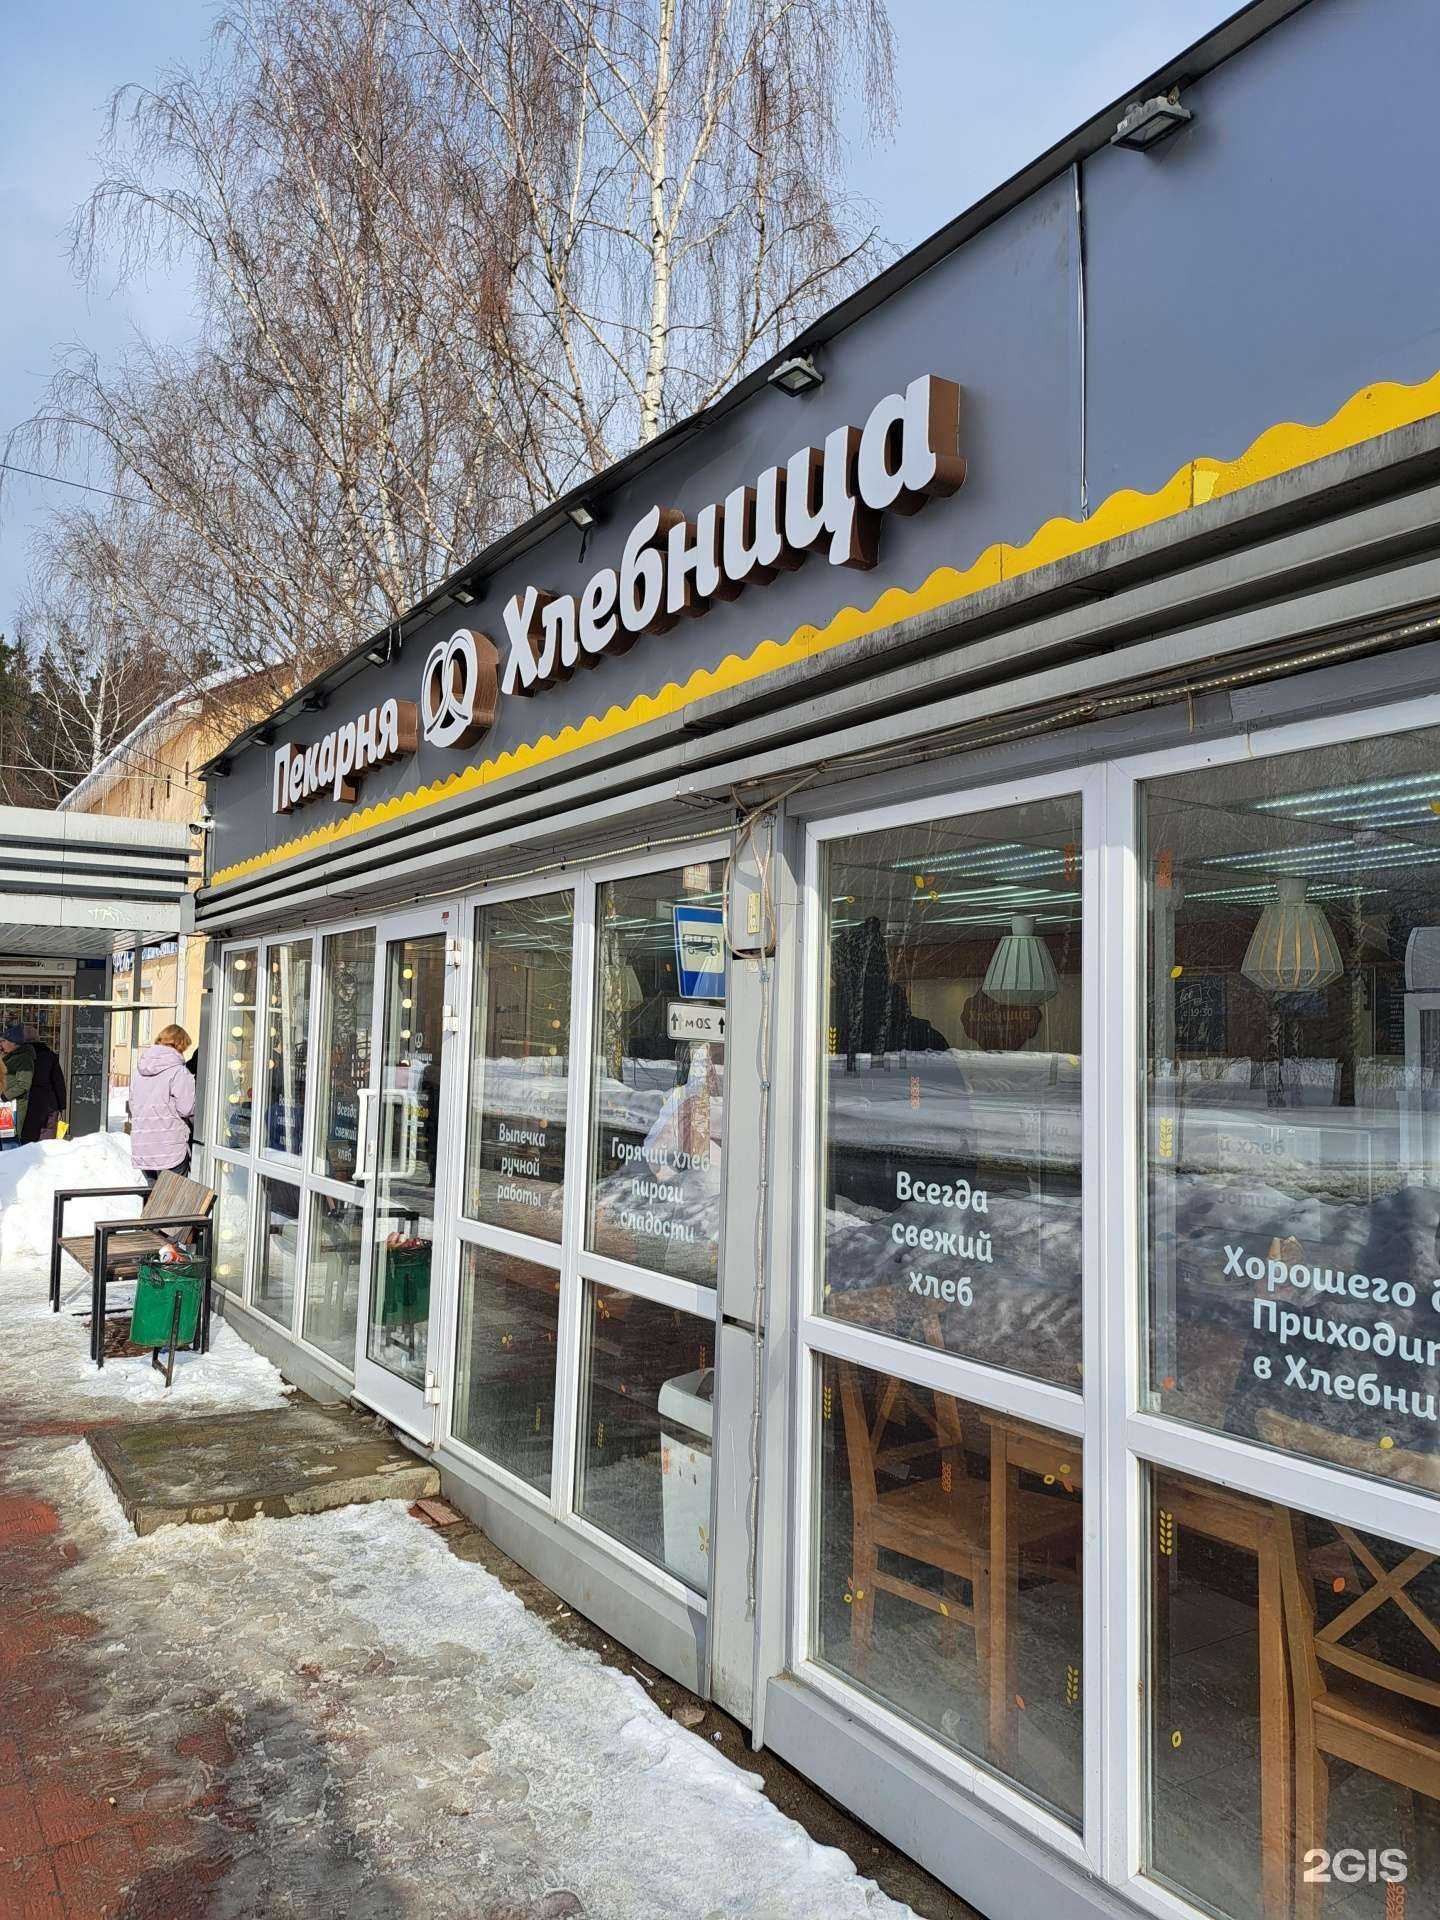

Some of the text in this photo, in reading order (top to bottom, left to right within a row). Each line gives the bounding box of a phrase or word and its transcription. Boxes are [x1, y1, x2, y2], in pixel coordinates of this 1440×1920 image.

[502, 374, 938, 696] Хлебница
[272, 698, 400, 814] Пекарня
[499, 1123, 546, 1147] Выпечка
[501, 1157, 540, 1177] ручной
[611, 1136, 711, 1172] Горячий хлеб
[497, 1184, 542, 1207] работы
[631, 1177, 684, 1204] пироги
[896, 1171, 989, 1213] Всегда
[620, 1211, 695, 1244] сладости
[891, 1222, 994, 1264] свежий
[908, 1271, 974, 1307] хлеб
[1222, 1244, 1416, 1308] Хорошего
[1253, 1353, 1438, 1421] в Хлебни
